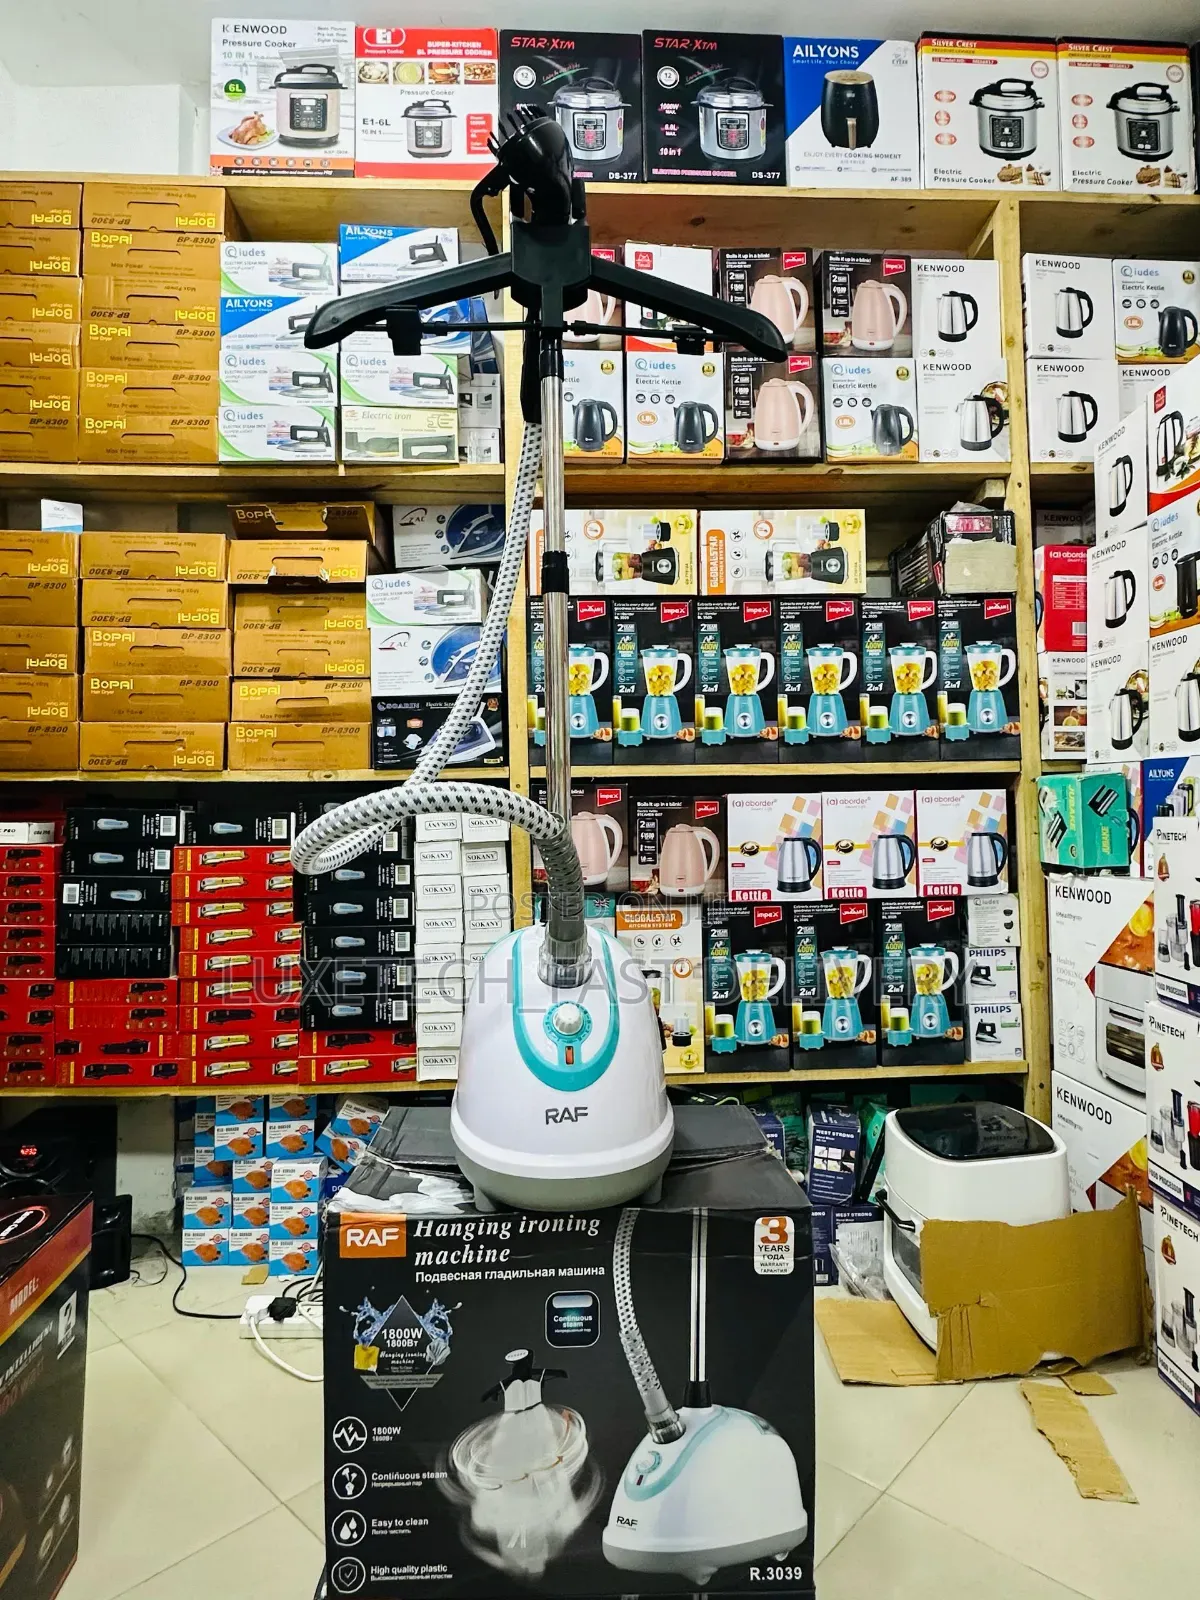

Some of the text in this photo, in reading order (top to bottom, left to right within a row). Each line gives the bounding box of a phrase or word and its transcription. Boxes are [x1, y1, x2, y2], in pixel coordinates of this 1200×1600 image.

[222, 39, 296, 49] Pressure Cooker
[222, 51, 234, 60] 10
[792, 44, 860, 59] AILYONS
[228, 83, 243, 93] 6L
[400, 89, 455, 97] Pressure Cooker
[362, 117, 391, 127] E1-6L
[844, 152, 873, 160] COOKING
[608, 172, 638, 181] DS-377
[752, 171, 781, 180] DS-377
[934, 168, 963, 176] Electric
[1072, 169, 1102, 177] Electric
[934, 176, 995, 185] Pressure Cooker
[1072, 178, 1133, 187] Pressure Cooker
[91, 217, 131, 226] BP-8300
[884, 263, 904, 271] impex
[917, 264, 965, 274] KENWOOD
[1035, 259, 1081, 270] KENWOOD
[225, 298, 274, 309] AILYONS
[90, 310, 131, 319] BP-8300
[176, 328, 216, 337] BP-8300
[922, 363, 972, 372] KENWOOD
[1036, 364, 1085, 373] KENWOOD
[1122, 368, 1171, 378] KENWOOD
[635, 378, 682, 387] Electric Kettle
[832, 382, 857, 390] Electric
[361, 411, 412, 421] Electric iron
[29, 418, 69, 426] BP-8300
[170, 419, 210, 427] BP-8300
[1097, 425, 1126, 451] KENWOOD
[1091, 540, 1127, 561] KENWOOD
[710, 535, 719, 588] GLOBALSTAR
[88, 567, 130, 577] BP-8300
[663, 605, 686, 616] impex
[745, 605, 769, 615] impex
[828, 605, 852, 614] impex
[910, 605, 933, 615] impex
[90, 614, 132, 623] BP-8300
[181, 633, 221, 641] BP-8300
[1151, 634, 1188, 651] KENWOOD
[1090, 654, 1122, 669] KENWOOD
[241, 664, 281, 674] BP-8300
[324, 681, 364, 691] BP-8300
[27, 726, 68, 734] BP-8300
[321, 727, 361, 736] BP-8300
[1148, 768, 1175, 777] AILYONS
[599, 791, 619, 800] impex
[1156, 829, 1187, 842] PINETECH
[420, 852, 450, 861] SOKANY
[467, 853, 496, 862] SOKANY
[424, 886, 453, 894] SOKANY
[470, 886, 499, 895] SOKANY
[831, 887, 864, 898] Kettle
[926, 884, 959, 896] Kettle
[1055, 885, 1112, 905] KENWOOD
[735, 890, 768, 901] Kettle
[624, 913, 677, 923] GLOBALSTAR
[756, 911, 780, 921] impex
[425, 919, 455, 928] SOKANY
[471, 920, 501, 929] SOKANY
[969, 948, 1007, 957] PHILIPS
[424, 955, 454, 963] SOKANY
[424, 989, 453, 997] SOKANY
[1166, 984, 1187, 998] PROCESSOR
[974, 1005, 1012, 1014] PHILIPS
[424, 1023, 454, 1031] SOKANY
[1150, 1016, 1185, 1040] PINETECH
[425, 1057, 454, 1066] SOKANY
[1056, 1086, 1113, 1126] KENWOOD
[545, 1106, 589, 1125] RAF
[815, 1128, 855, 1139] WEST STRONG
[1159, 1174, 1182, 1196] PROCESSOR
[413, 1214, 601, 1241] Hanging ironing
[1160, 1204, 1199, 1242] PINETECH
[760, 1216, 789, 1244] 3
[346, 1226, 400, 1247] RAF
[757, 1243, 791, 1253] YEARS
[414, 1244, 512, 1266] machine
[762, 1253, 786, 1261] ГОДА
[415, 1265, 605, 1283] Подвесная гладильная машина
[9, 1277, 40, 1317] MODEL:
[553, 1314, 593, 1323] Continuous
[381, 1328, 424, 1340] 1800W
[1169, 1367, 1193, 1395] PROCESSOR
[372, 1426, 402, 1436] 1800W
[421, 1470, 448, 1480] steam
[371, 1517, 429, 1528] Easy to clean
[616, 1515, 639, 1528] RAF
[370, 1563, 449, 1576] High quality plastic
[749, 1566, 803, 1581] R.3039
